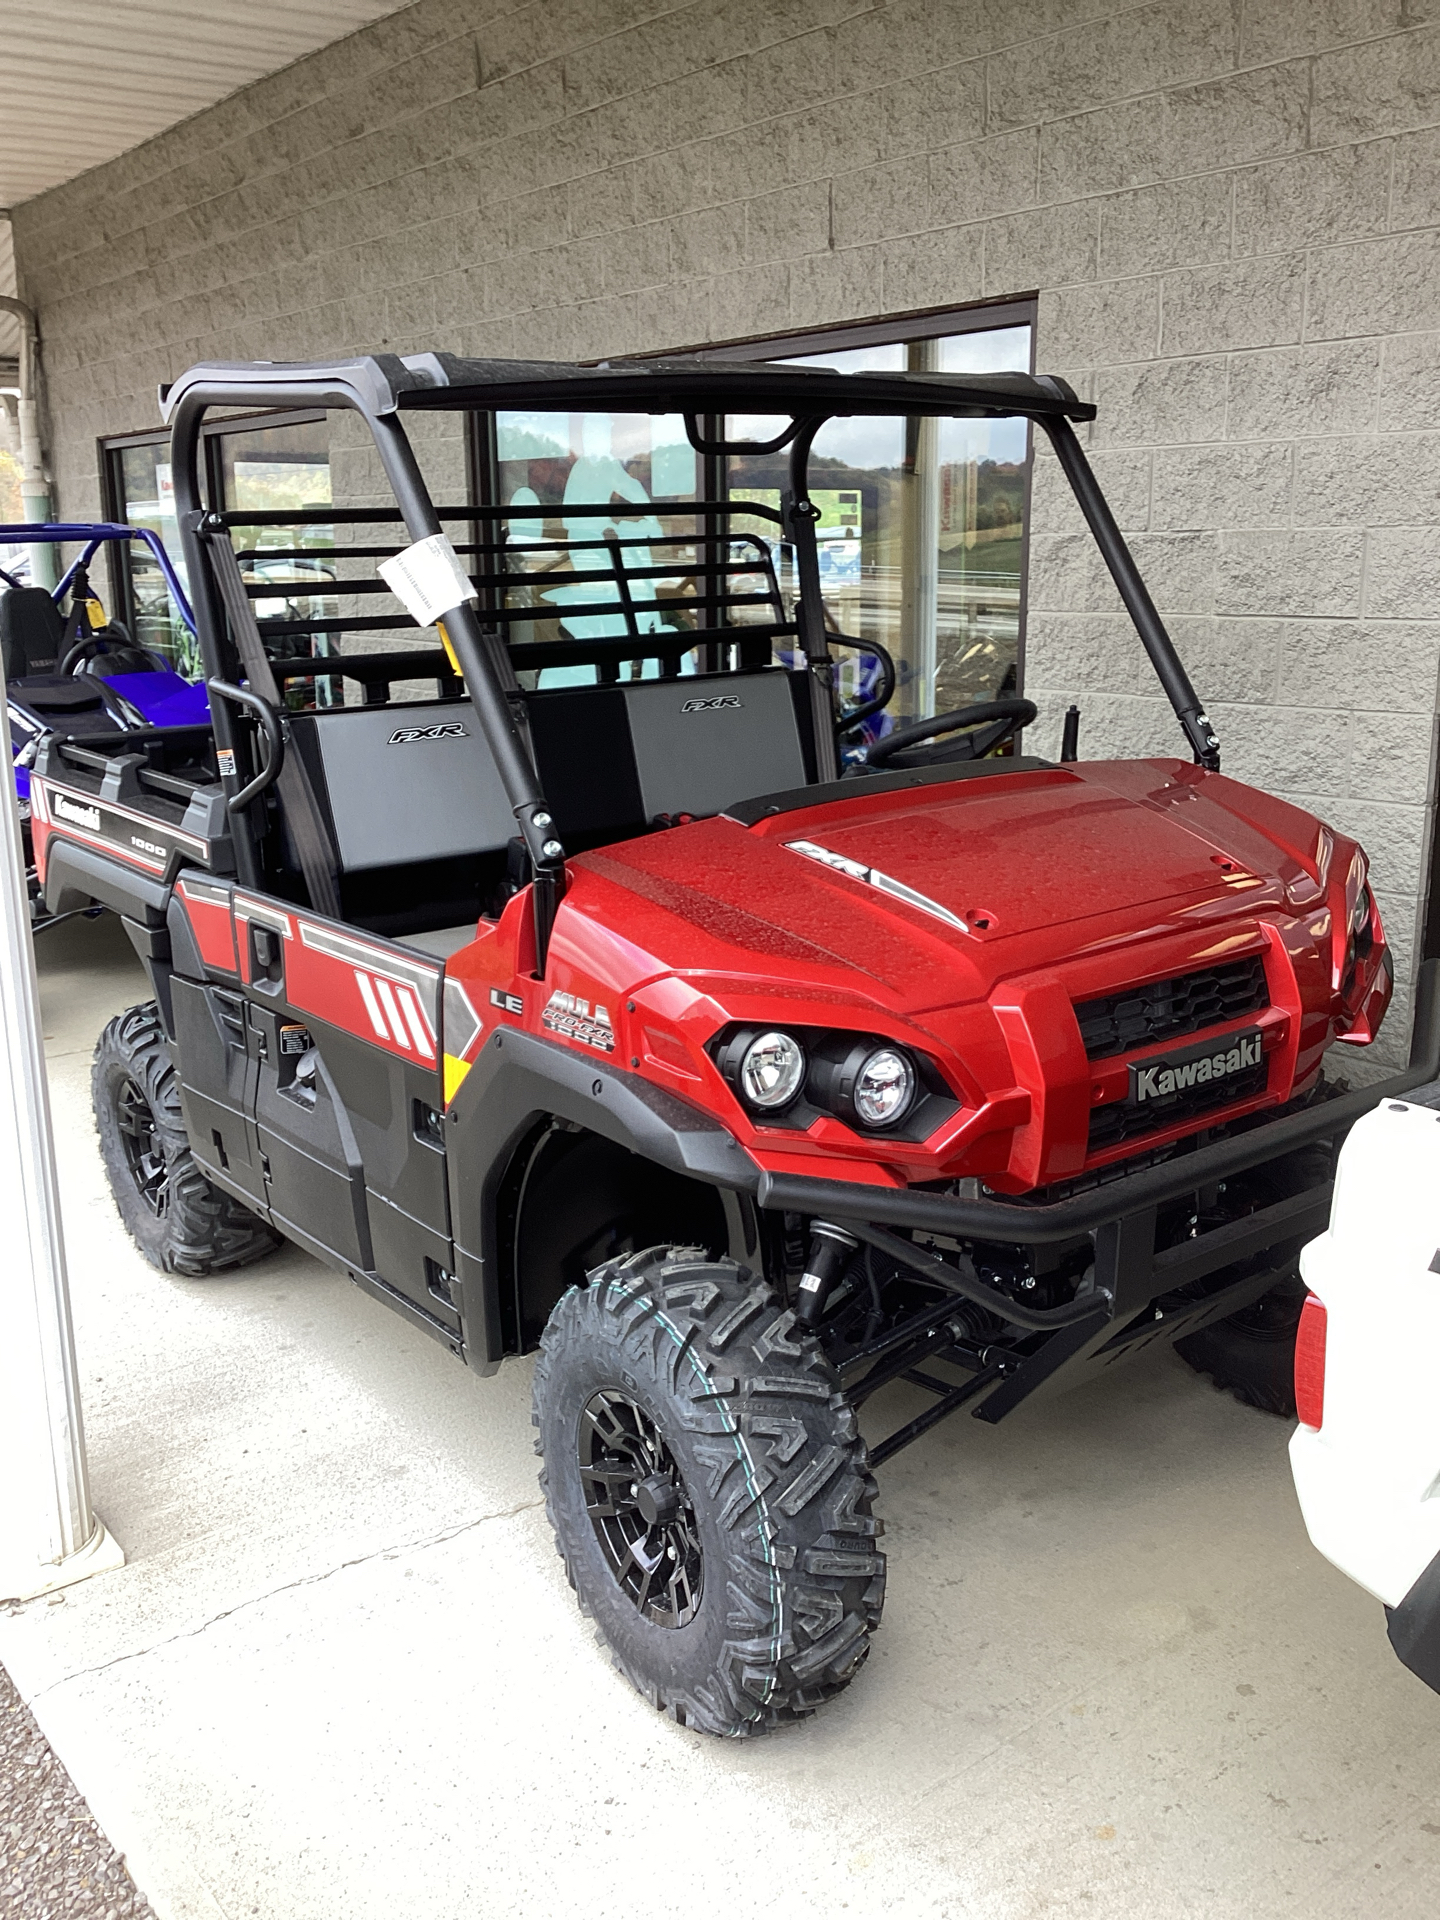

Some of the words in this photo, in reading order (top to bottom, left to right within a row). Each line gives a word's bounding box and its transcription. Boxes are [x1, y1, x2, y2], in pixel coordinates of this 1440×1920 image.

[681, 695, 742, 713] FXR
[387, 722, 468, 744] FXR
[130, 836, 167, 857] 1000
[784, 840, 871, 882] FXR
[490, 989, 523, 1015] LE
[545, 989, 613, 1032] MULE
[549, 1020, 608, 1051] 1000
[1137, 1033, 1262, 1102] Kawasaki
